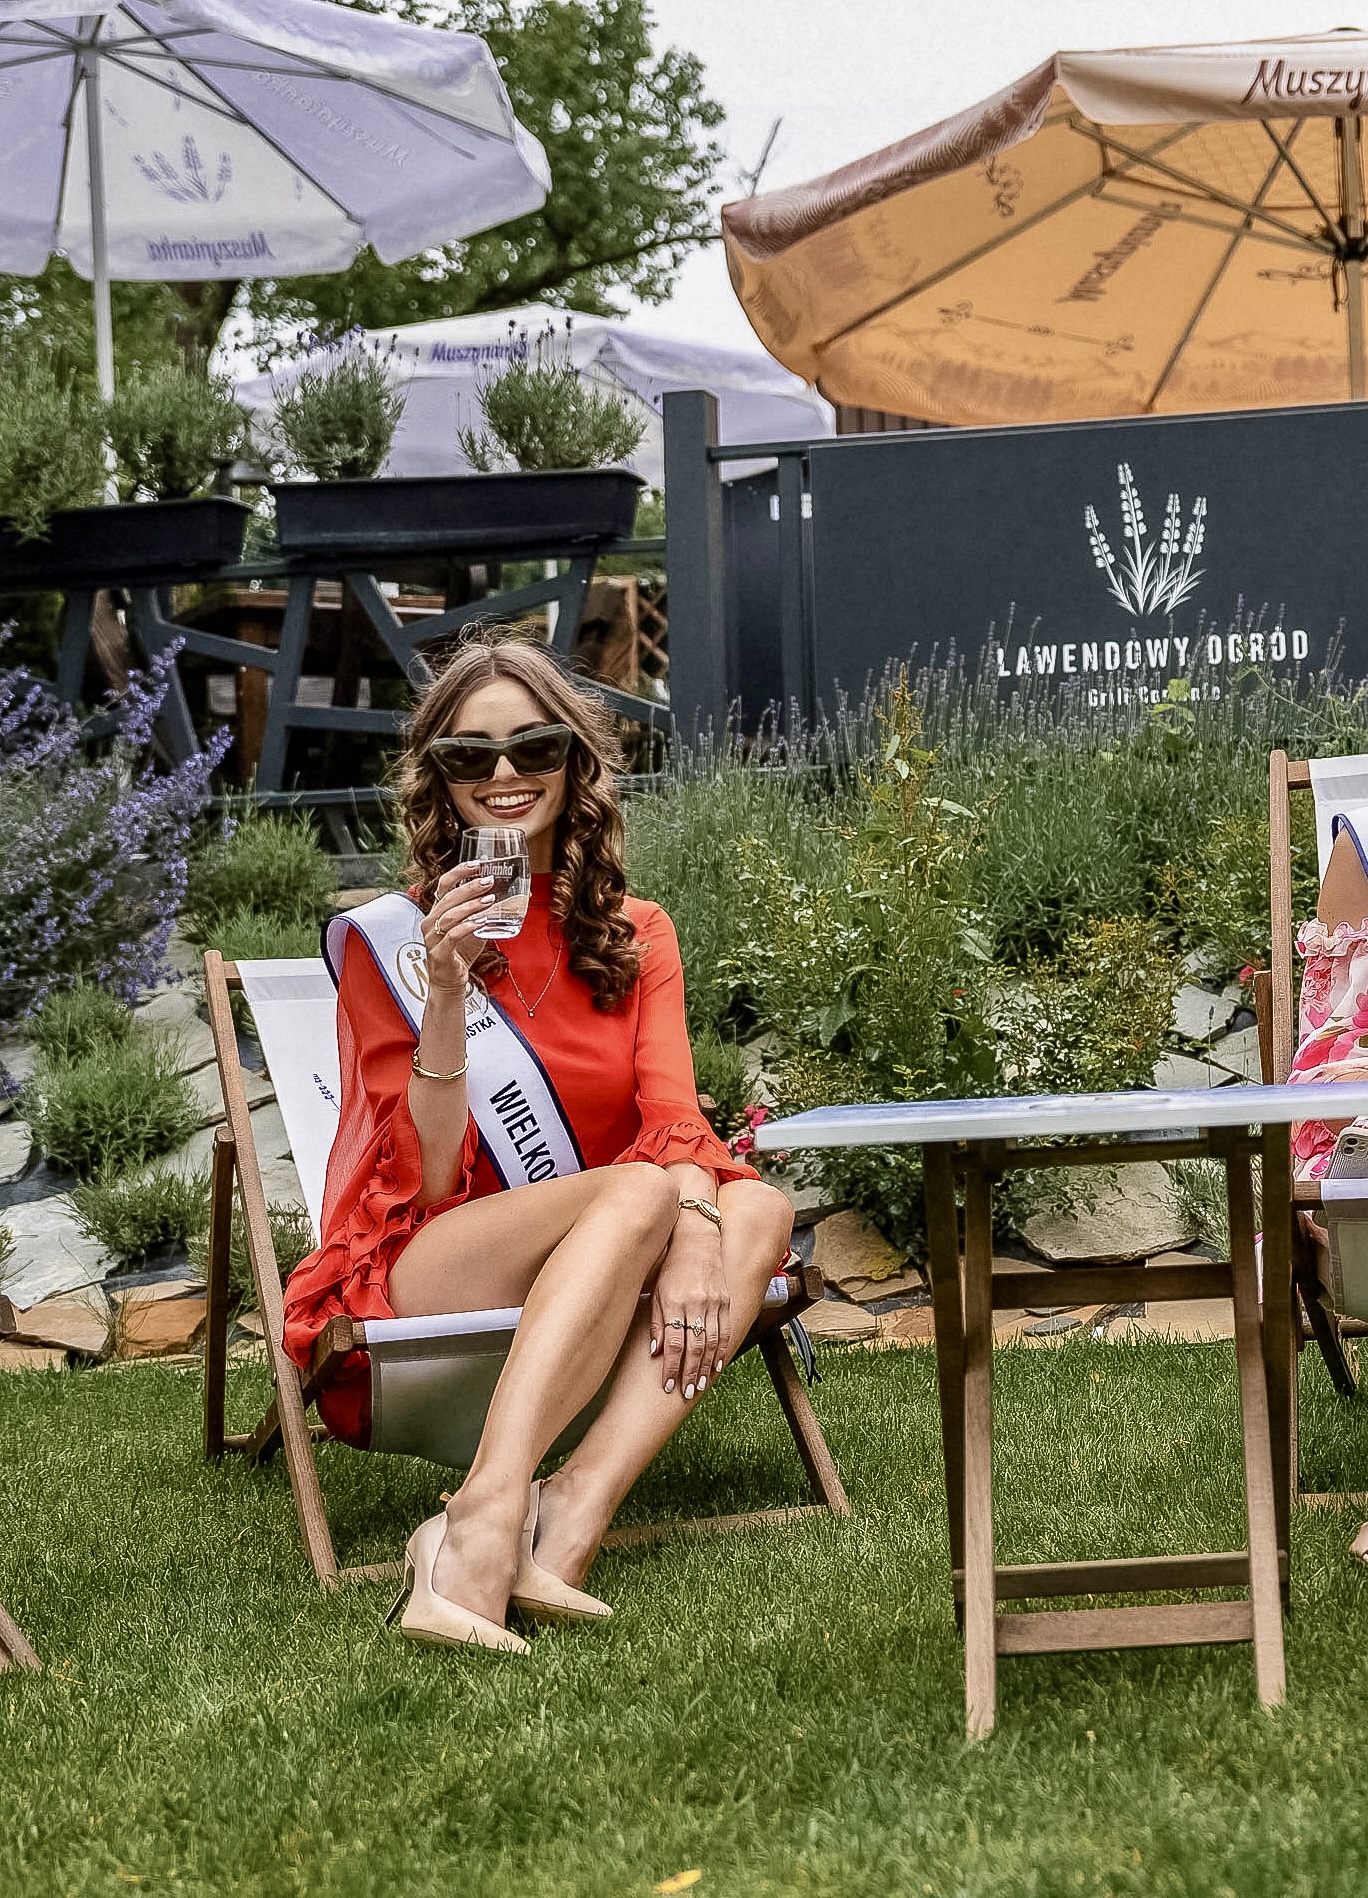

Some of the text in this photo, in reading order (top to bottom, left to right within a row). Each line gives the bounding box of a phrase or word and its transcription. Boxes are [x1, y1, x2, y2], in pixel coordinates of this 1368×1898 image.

[998, 626, 1309, 677] LAWENDOWY OGRÓD
[479, 861, 513, 877] ynianka
[465, 996, 481, 1016] SKI
[465, 1016, 497, 1039] ISTKA
[489, 1079, 559, 1184] WIELKO
